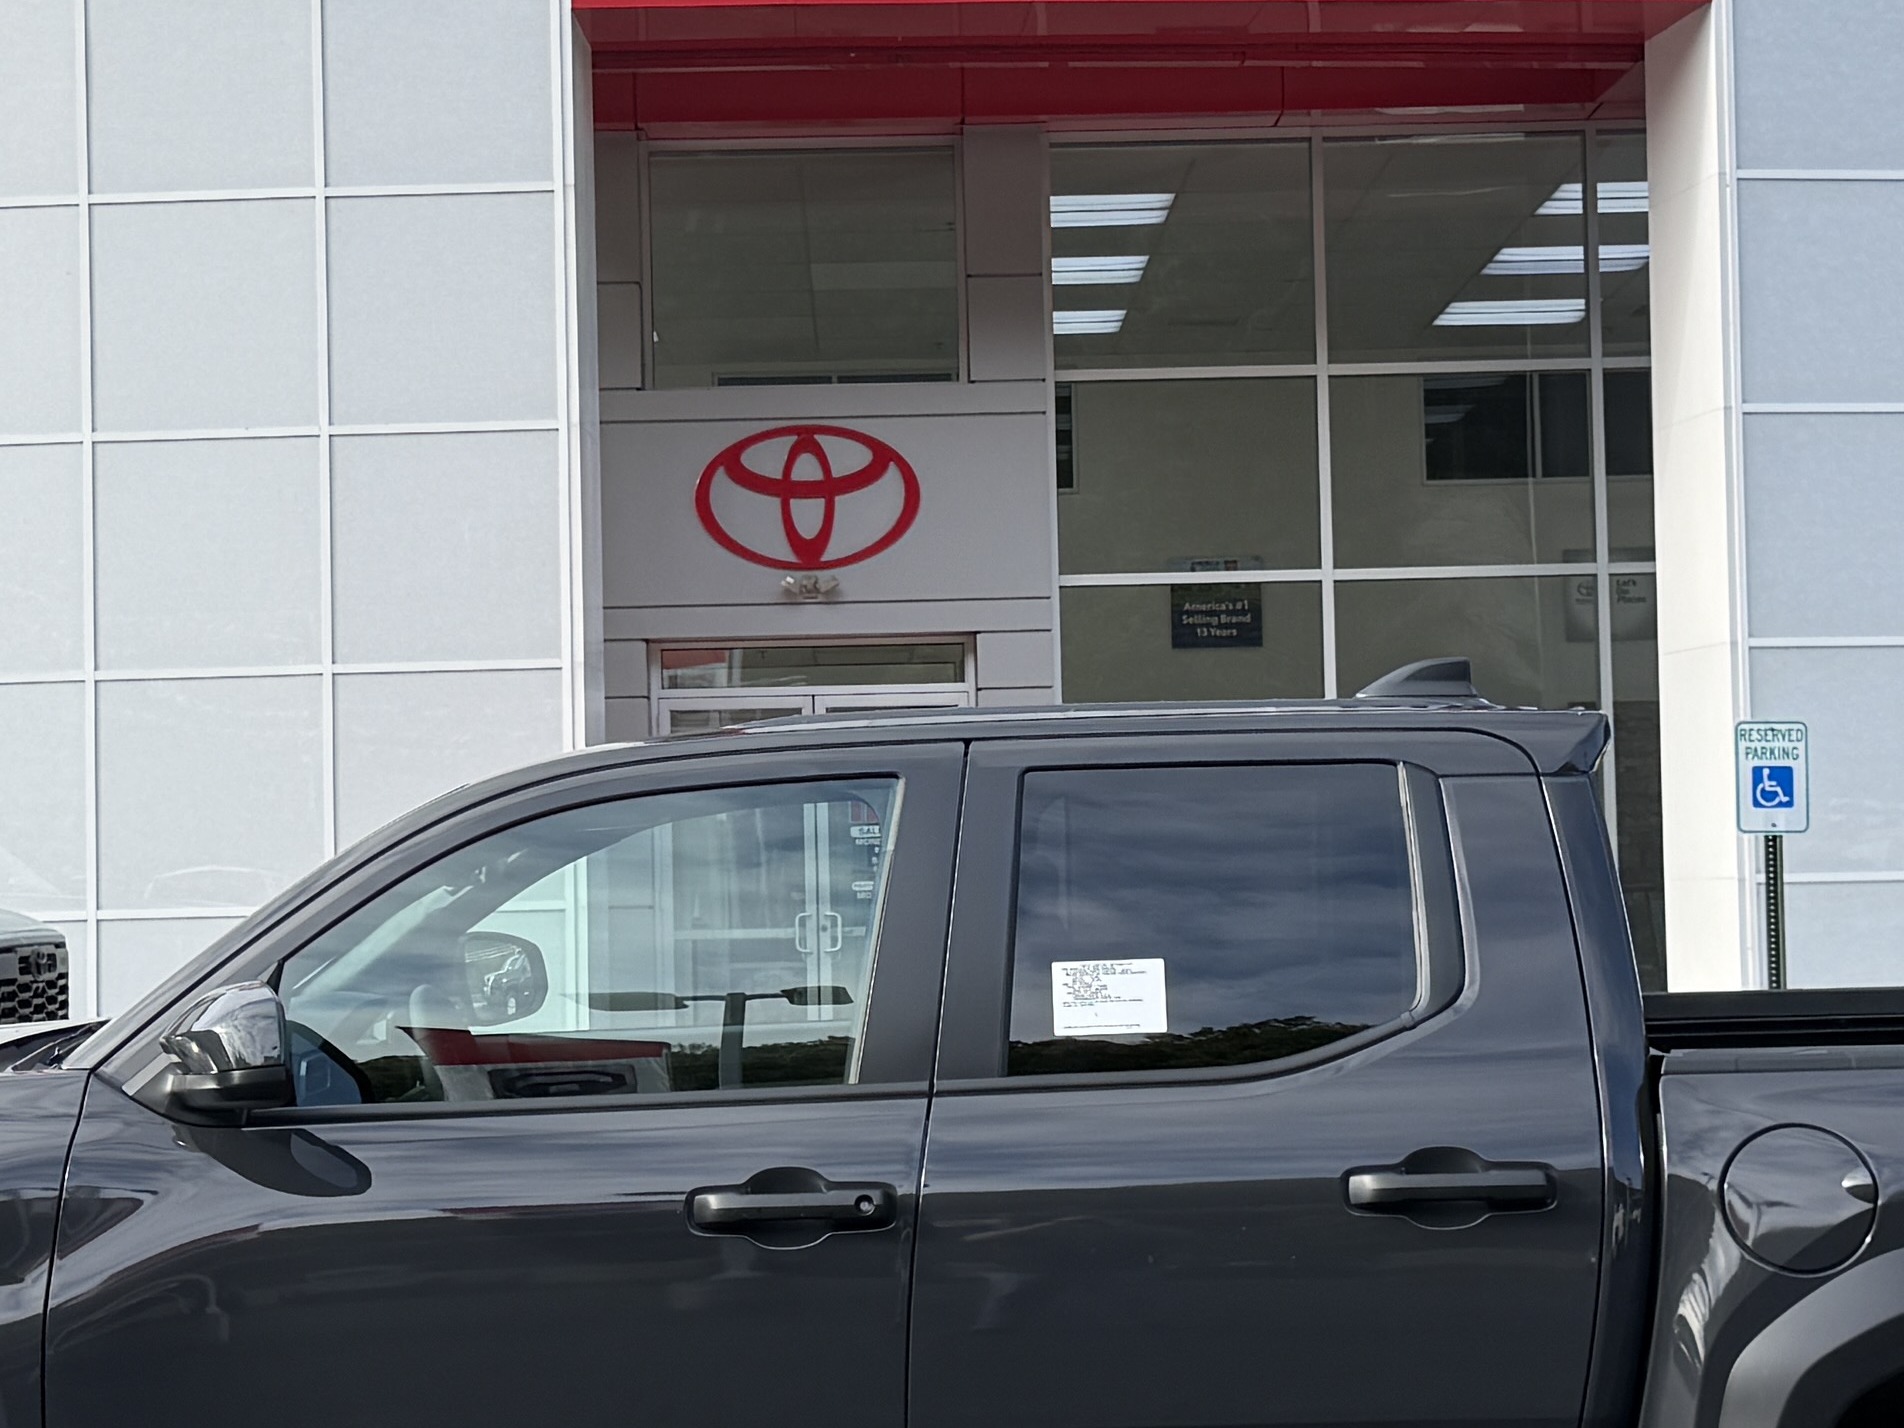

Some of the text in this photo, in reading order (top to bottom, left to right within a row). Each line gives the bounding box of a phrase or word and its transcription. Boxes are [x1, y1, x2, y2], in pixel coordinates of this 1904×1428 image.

[1184, 601, 1233, 611] America's
[1182, 613, 1251, 626] Selling Brand
[1209, 627, 1238, 637] Years
[1739, 728, 1803, 742] RESERVED
[1745, 746, 1800, 761] PARKING
